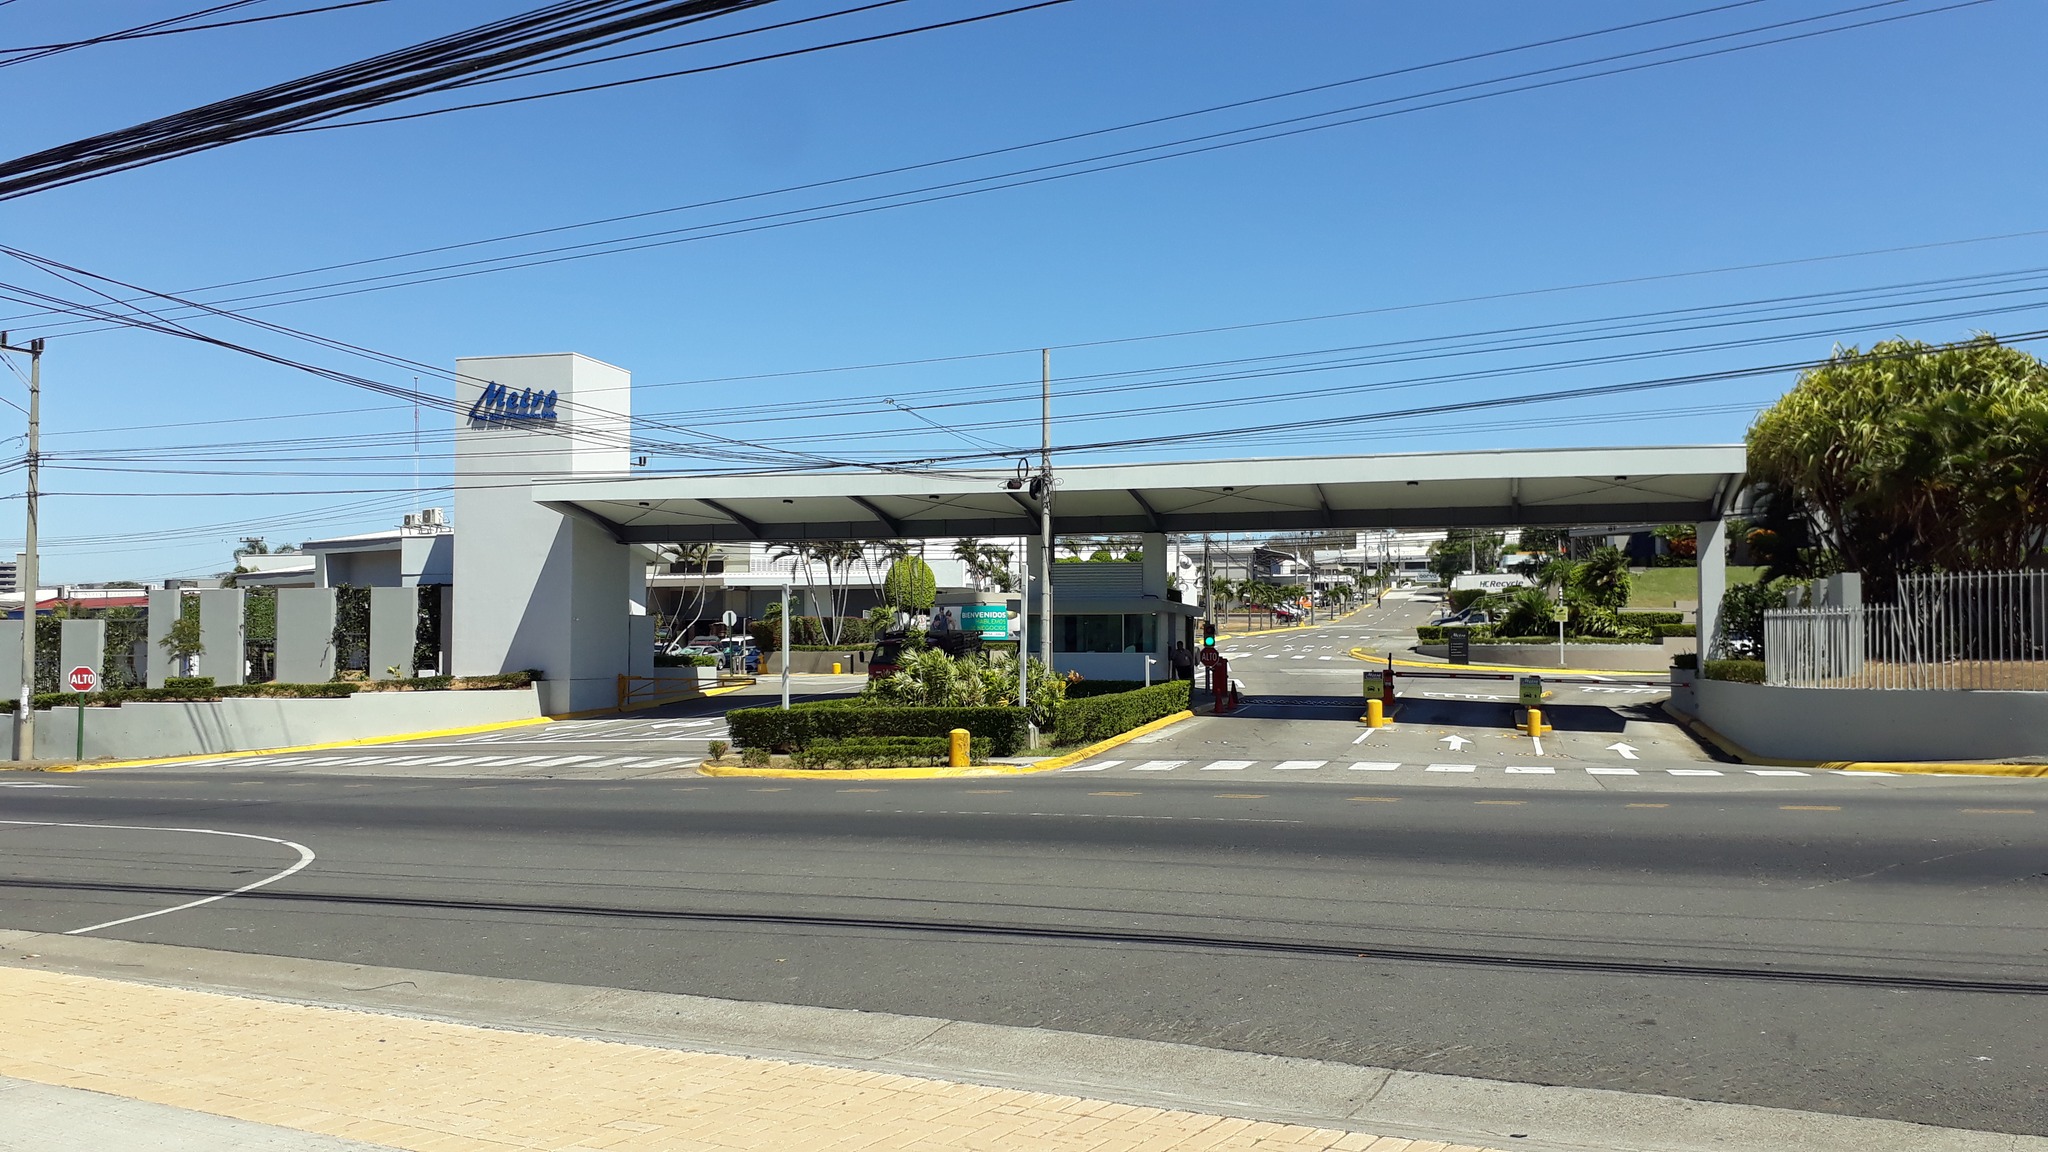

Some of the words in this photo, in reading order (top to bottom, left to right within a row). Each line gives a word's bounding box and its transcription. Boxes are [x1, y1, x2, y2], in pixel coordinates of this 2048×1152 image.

[469, 380, 557, 415] Metro
[962, 611, 1006, 619] BIENVENIDOS
[1201, 652, 1217, 661] ALTO
[71, 674, 94, 684] ALTO
